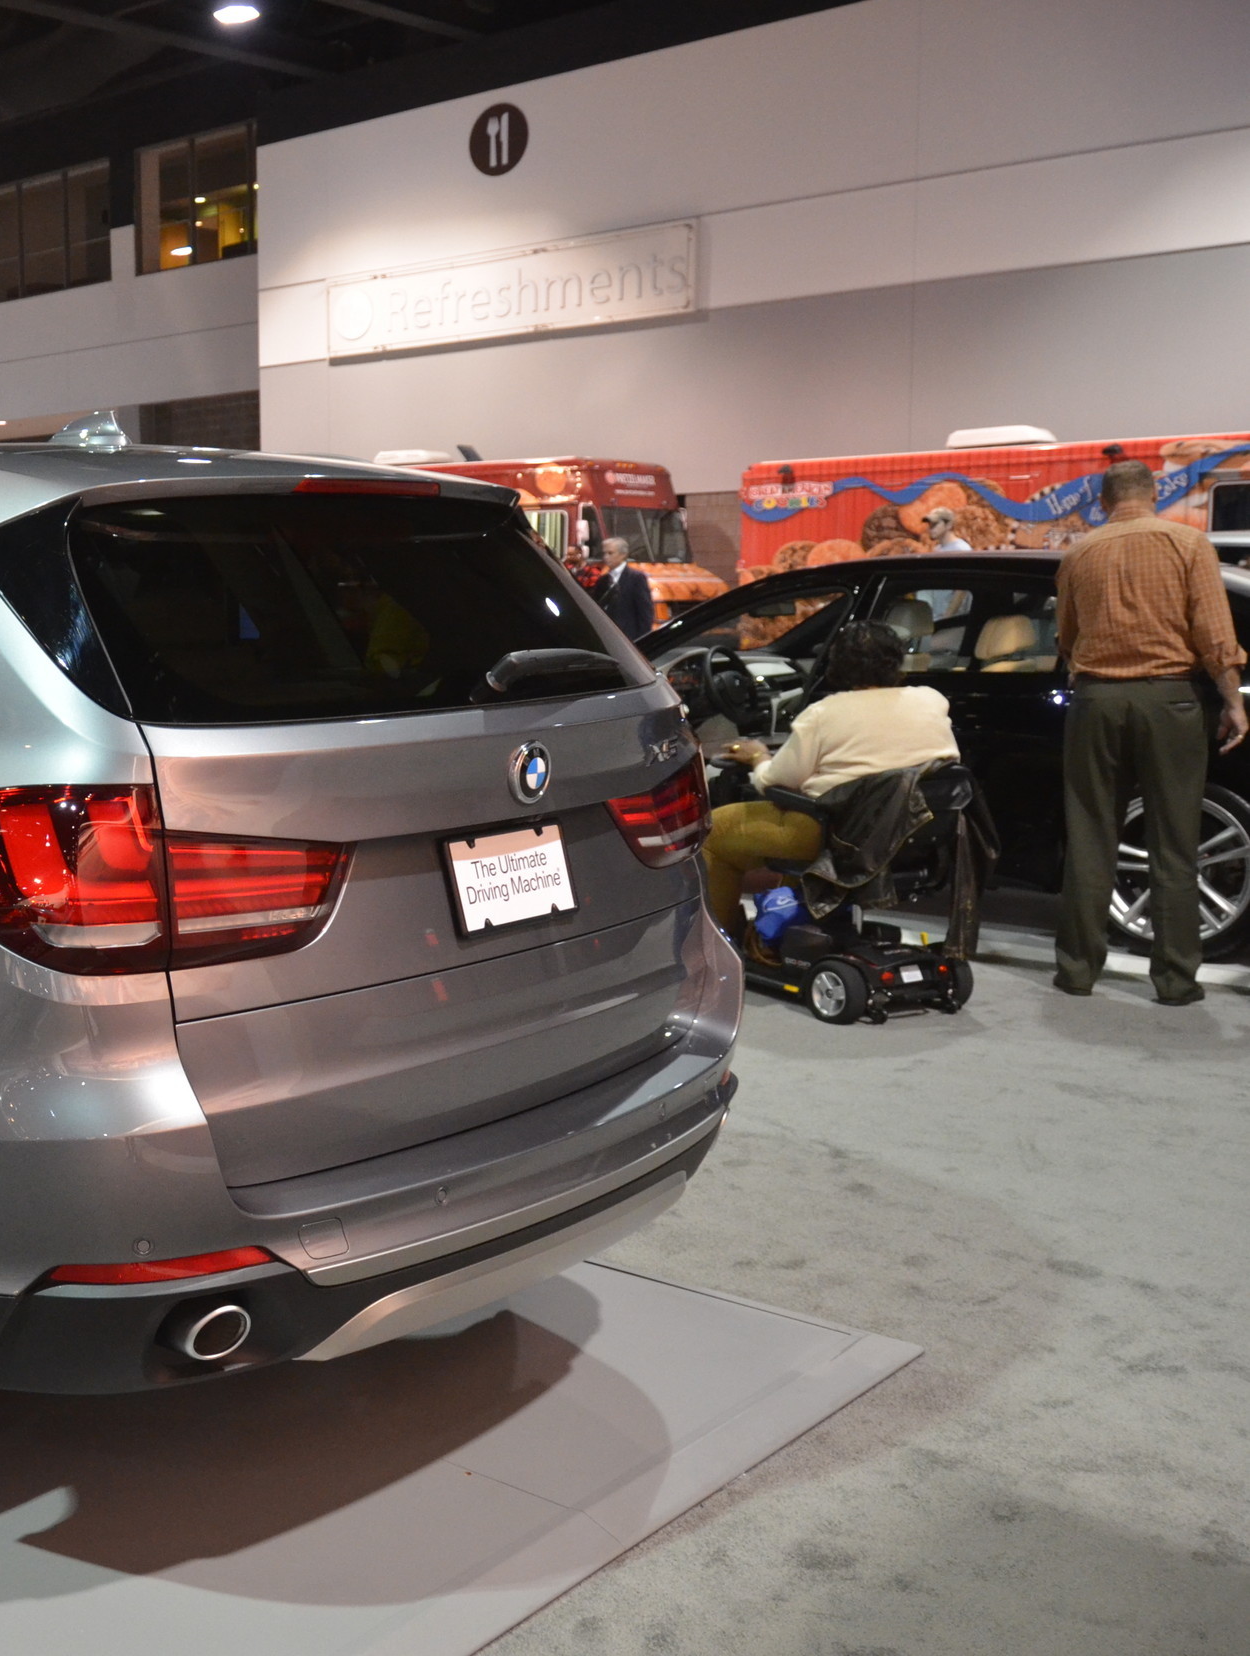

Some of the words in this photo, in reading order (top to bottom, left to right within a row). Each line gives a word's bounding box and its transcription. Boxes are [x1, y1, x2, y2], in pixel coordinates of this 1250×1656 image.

[385, 252, 689, 333] Refreshments
[470, 860, 497, 879] The
[498, 851, 548, 874] Ultimate
[466, 882, 510, 905] Driving
[510, 870, 562, 896] Machine
